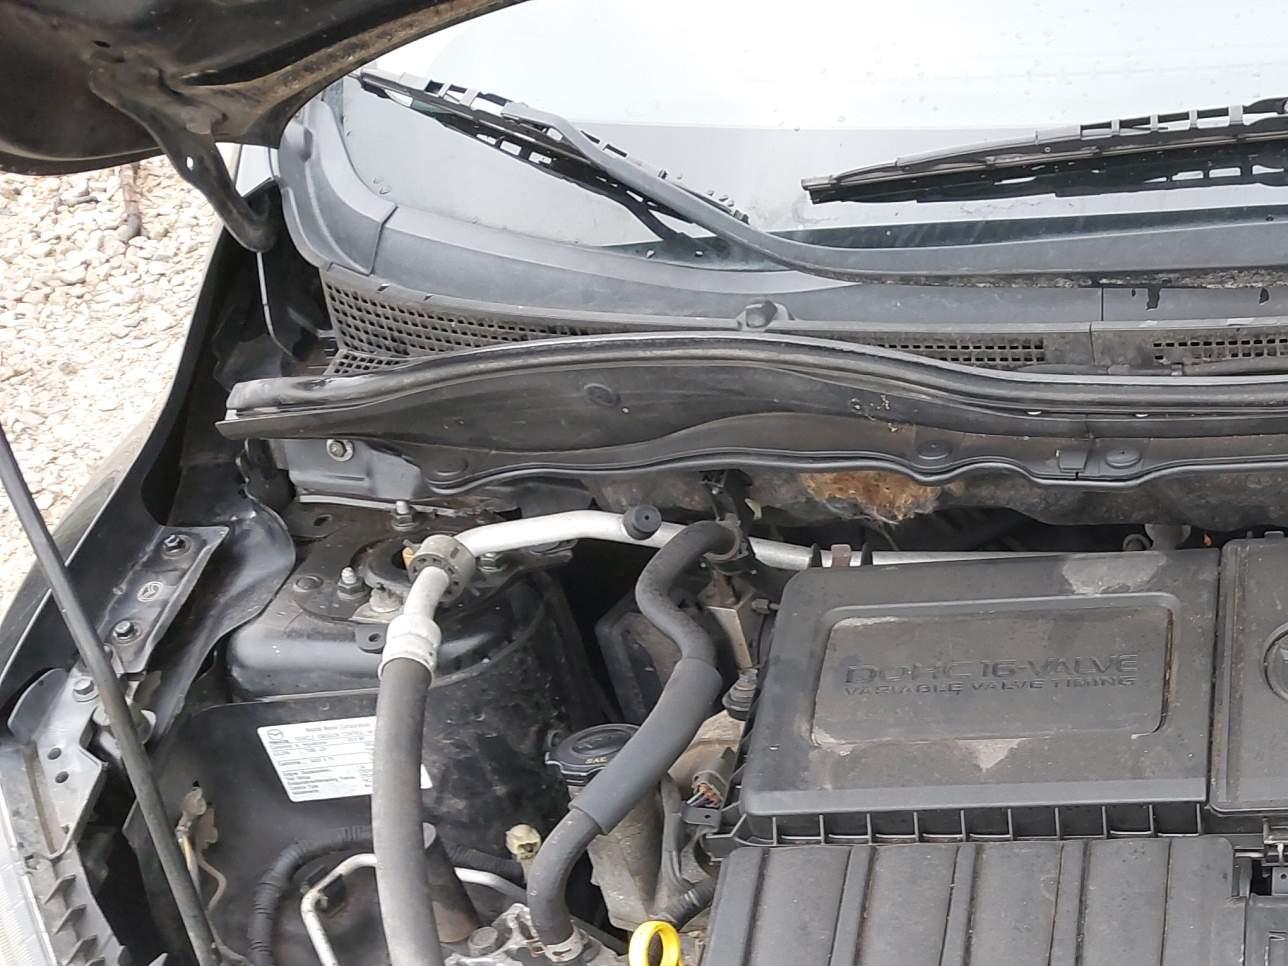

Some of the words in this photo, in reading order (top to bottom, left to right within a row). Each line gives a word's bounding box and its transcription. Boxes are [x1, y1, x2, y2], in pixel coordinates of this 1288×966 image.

[845, 662, 972, 683] DOHC
[979, 654, 1138, 678] 16-VALVE
[844, 682, 964, 696] VARIABLE
[971, 679, 1045, 691] VALVE
[1051, 676, 1137, 688] TIMING
